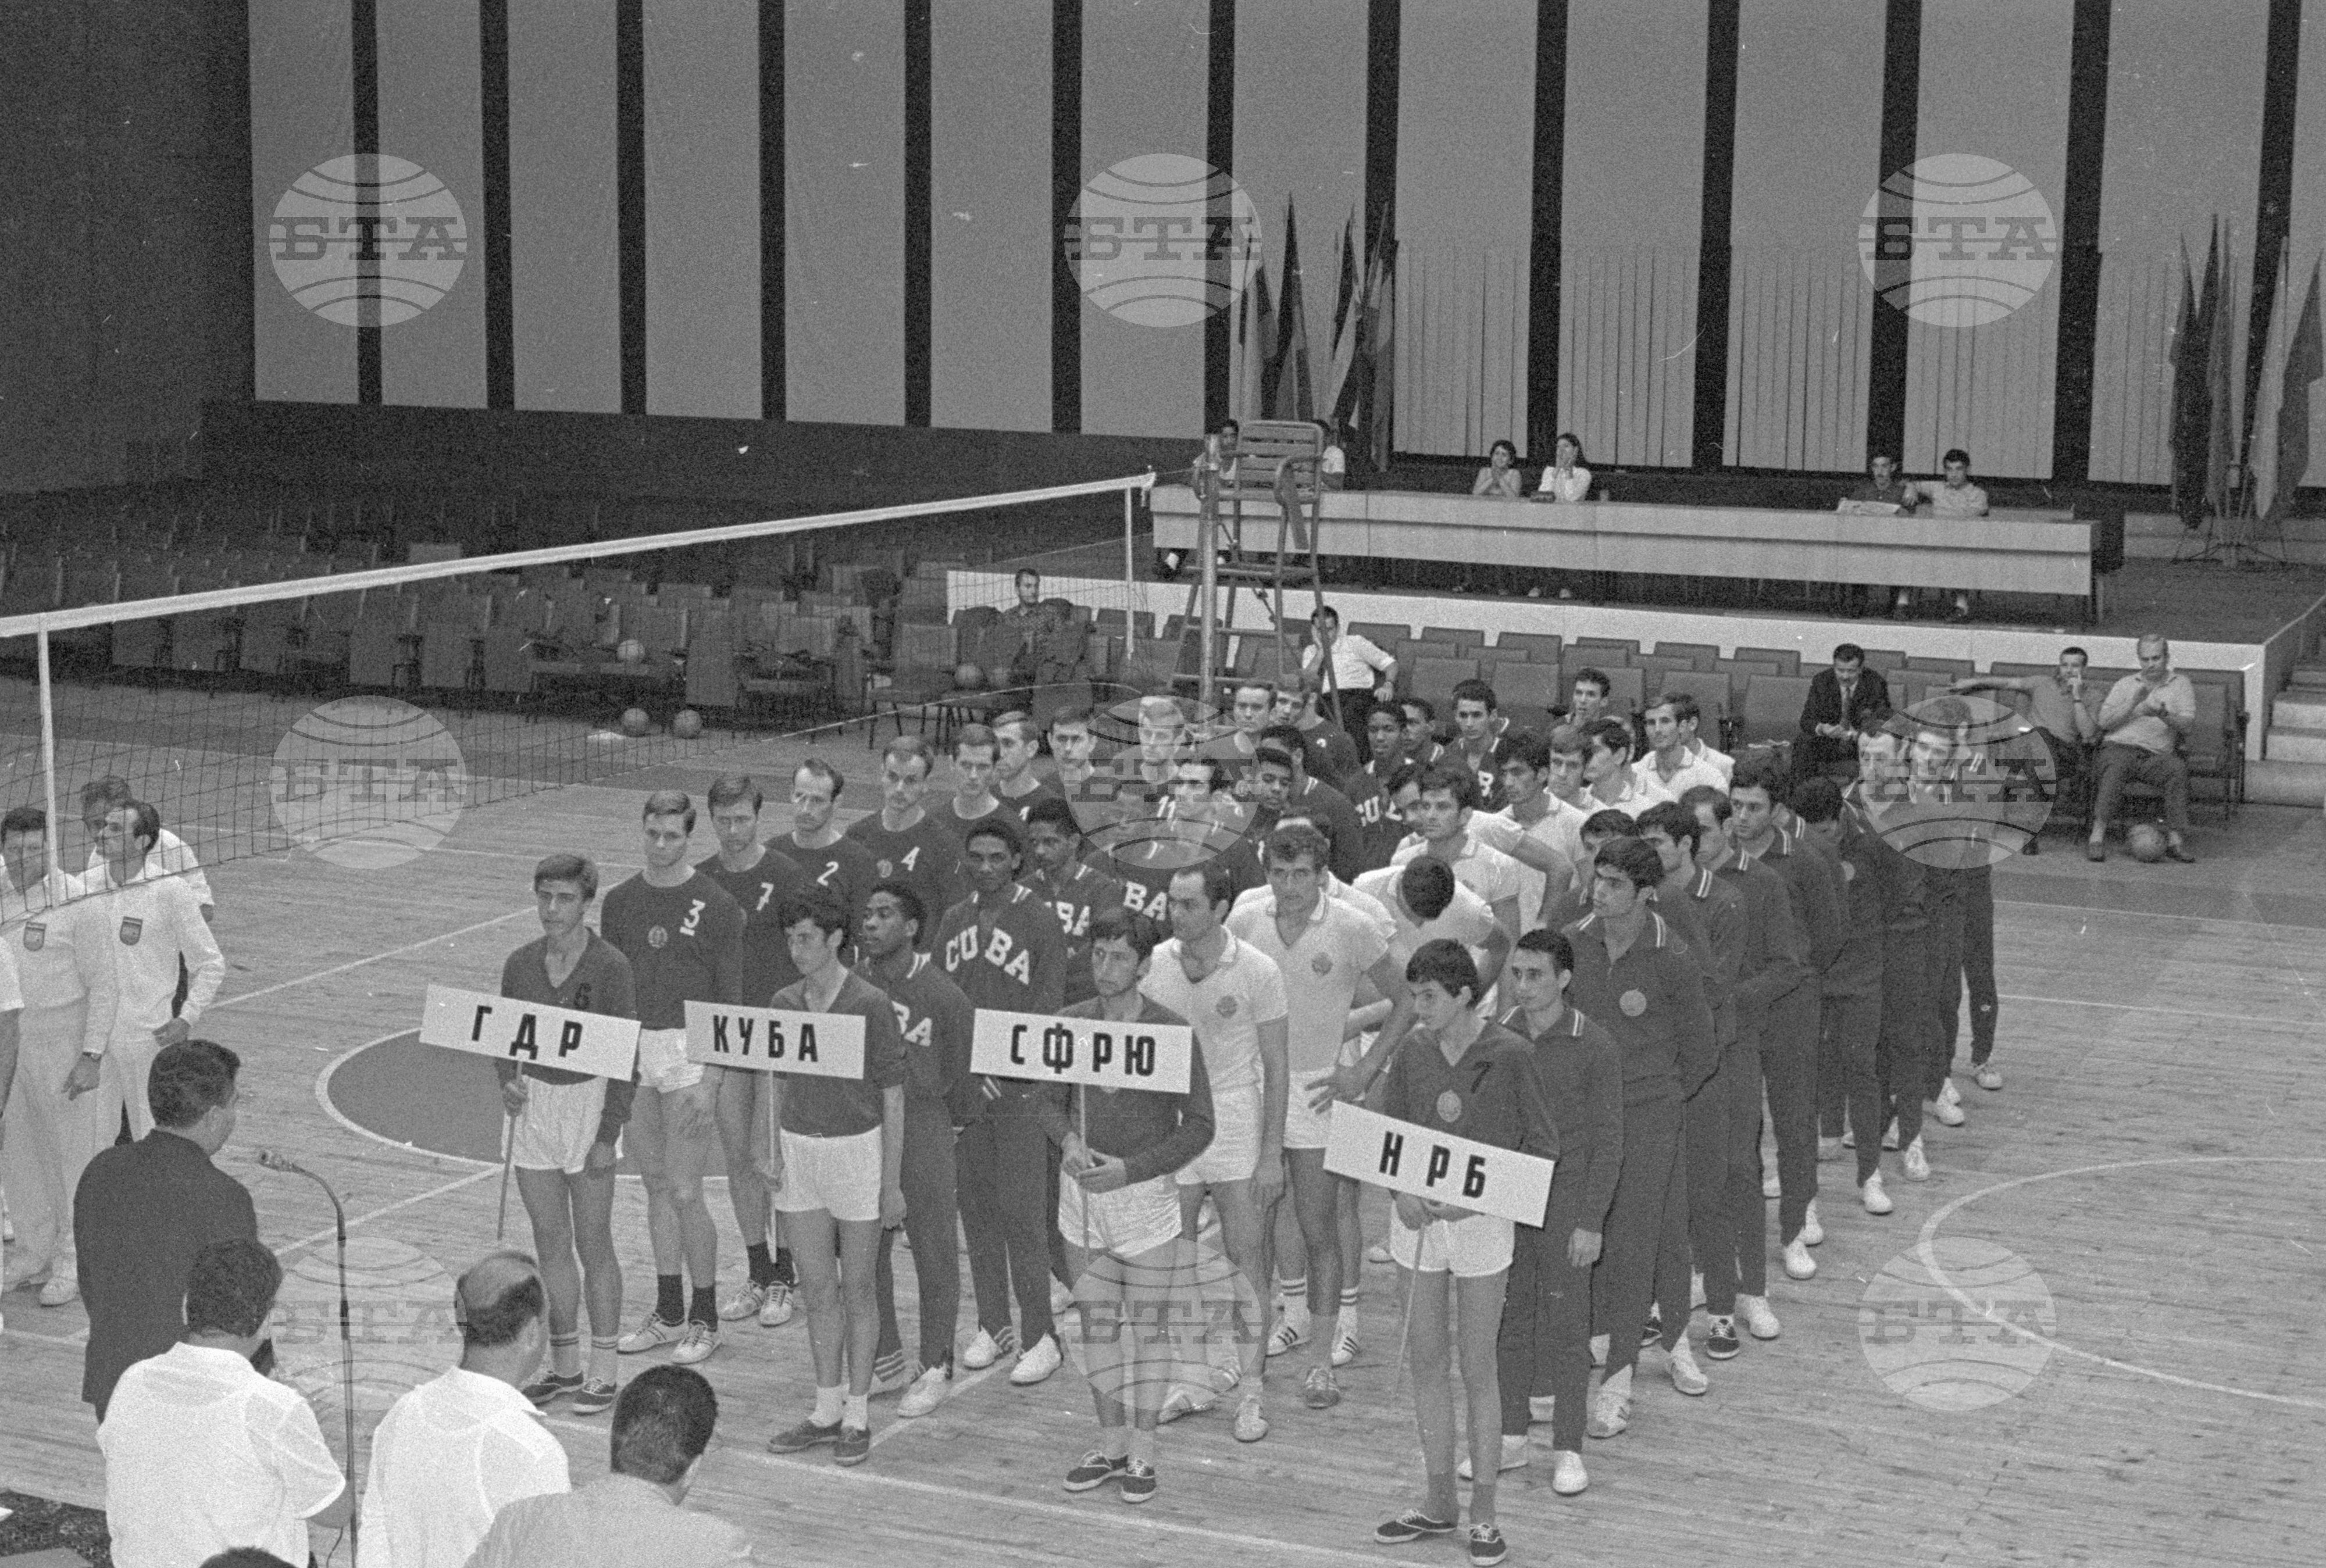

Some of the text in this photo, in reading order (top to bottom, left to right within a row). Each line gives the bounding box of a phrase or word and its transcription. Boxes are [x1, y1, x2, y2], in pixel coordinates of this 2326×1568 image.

[817, 861, 839, 886] 2
[901, 846, 920, 871] 4
[683, 899, 705, 928] 3
[757, 882, 774, 911] 7
[946, 925, 1029, 983] CUBA
[472, 1005, 583, 1060] ГДР
[713, 1015, 818, 1062] КУБА
[1011, 1023, 1155, 1076] СФРЮ
[1379, 1131, 1486, 1198] НРБ
